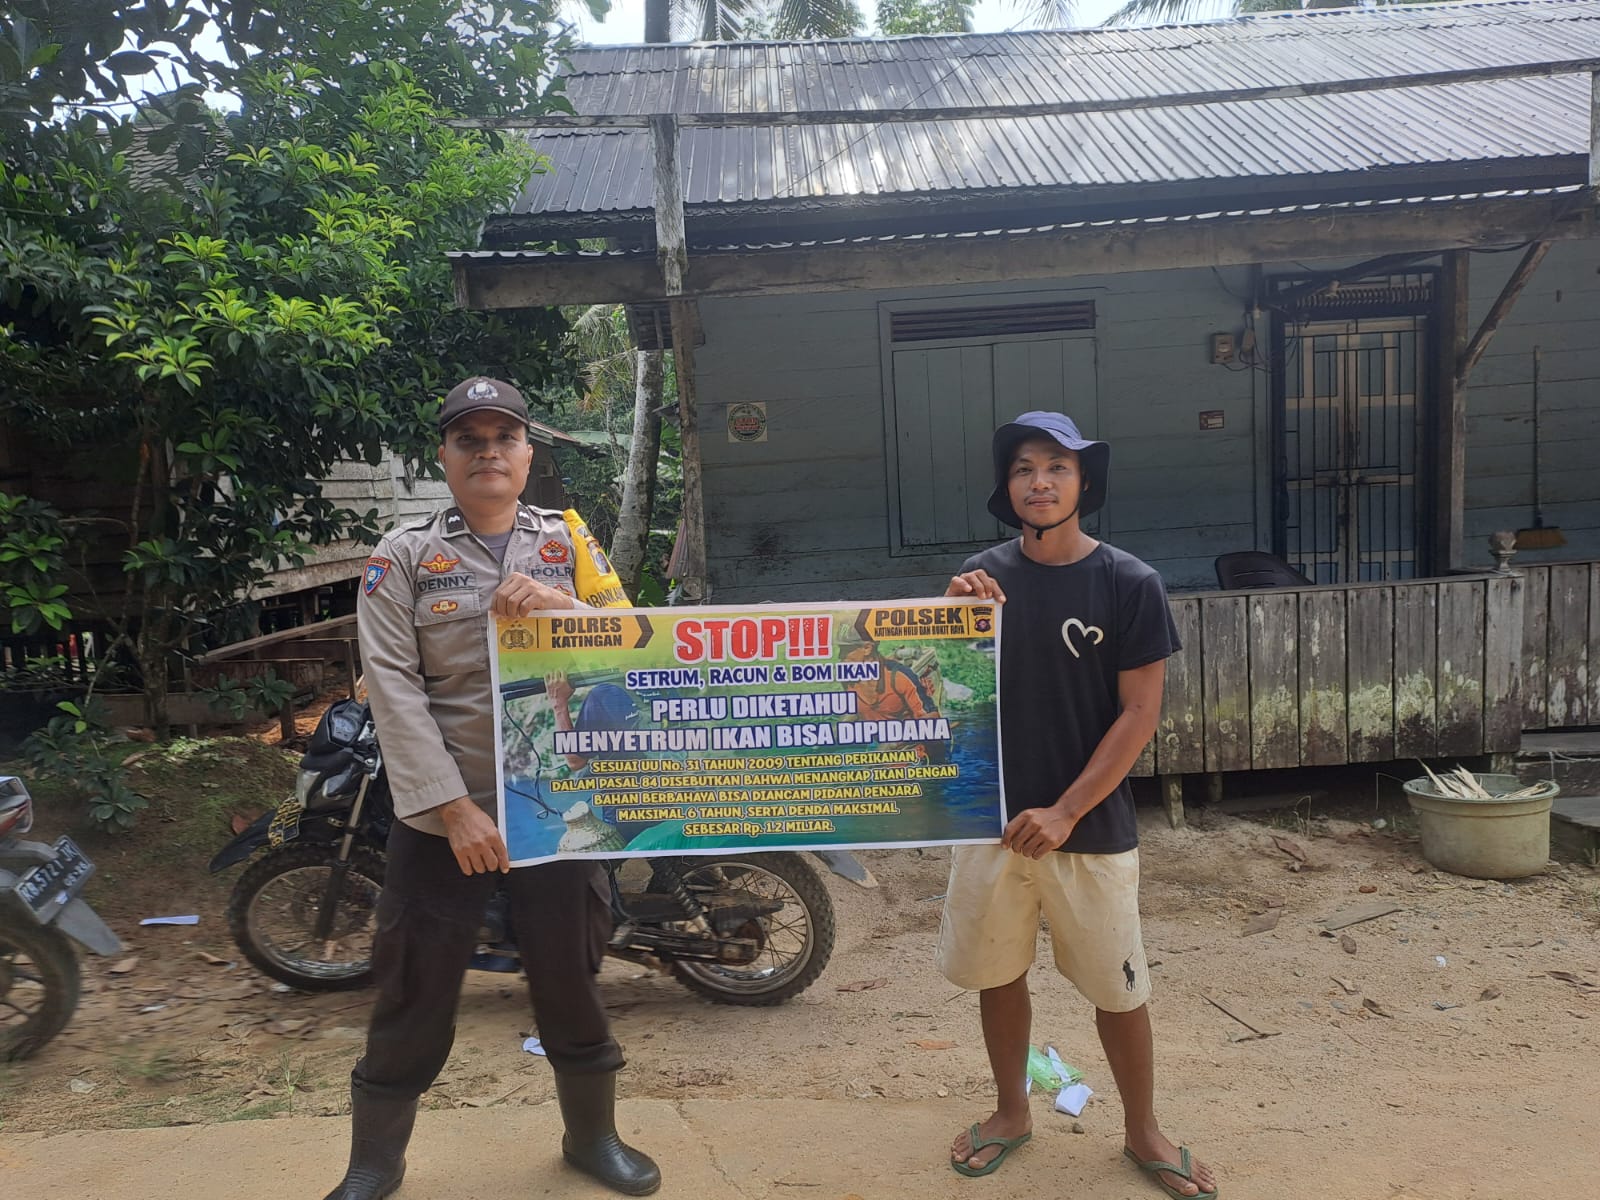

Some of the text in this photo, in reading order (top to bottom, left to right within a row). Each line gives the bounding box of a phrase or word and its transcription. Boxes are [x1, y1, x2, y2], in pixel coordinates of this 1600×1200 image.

[531, 566, 575, 578] POLR
[418, 575, 470, 592] DENNY
[551, 617, 622, 634] POLRES
[876, 608, 962, 626] POLSEK
[551, 634, 622, 649] KATINGAN
[676, 617, 830, 661] STOP!!!
[627, 664, 878, 690] SETRUM, RACUN & BOM IKAN
[652, 698, 726, 721] PERLU
[732, 692, 857, 718] DIKETAHUI
[554, 719, 950, 754] MENYETRUM IKAN BISA DIPIDANA
[592, 751, 918, 772] SESUAI UU No. 31 TAHUN 2009 TENTANG PERIKANAN,
[551, 765, 957, 791] DALAM PASAL 84 DISEBUTKAN BAHWA MENANGKAP IKAN DENGAN
[594, 784, 921, 805] BAHAN BERBAHAYA BISA DIANCAM PIDANA PENJARA
[618, 802, 897, 821] MAKSIMAL 6 TAHUN, SERTA DENDA MAKSIMAL
[684, 823, 741, 835] SEBESAR
[743, 822, 763, 836] Rp.
[785, 819, 834, 832] MILIAR.
